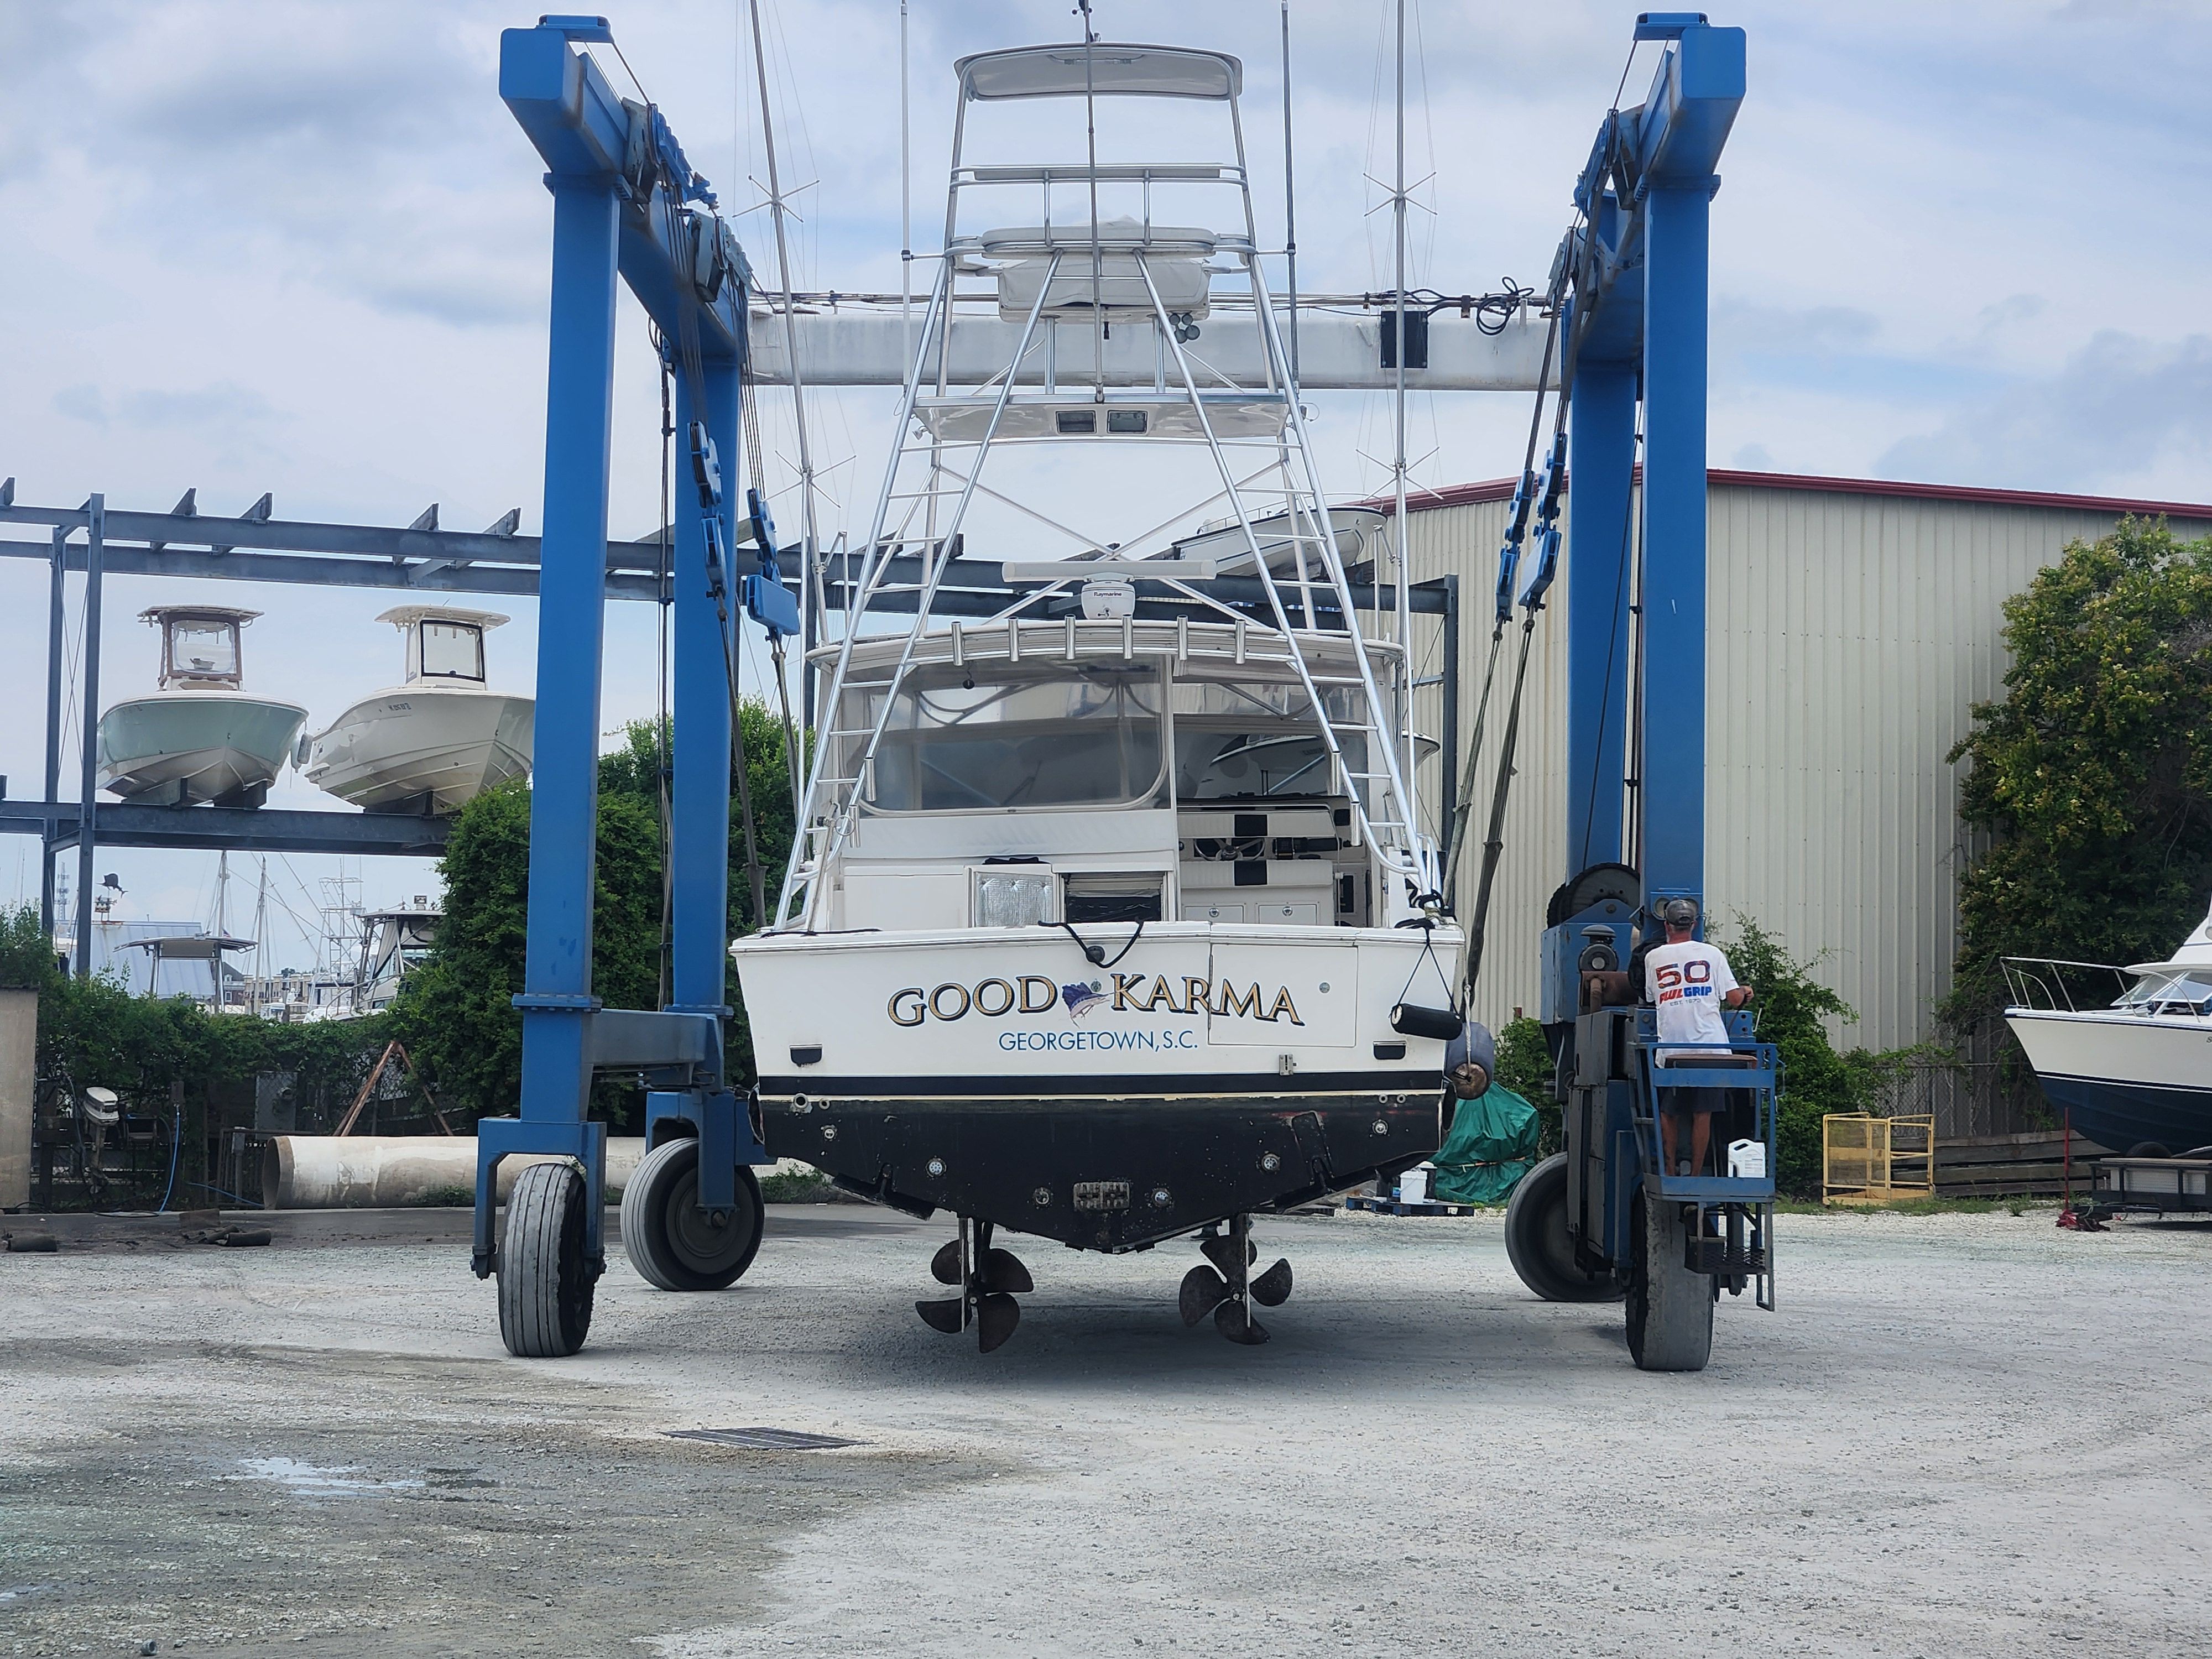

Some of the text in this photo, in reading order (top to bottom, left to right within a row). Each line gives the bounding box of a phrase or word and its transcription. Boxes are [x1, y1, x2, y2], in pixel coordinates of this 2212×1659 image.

[1656, 960, 1710, 988] 50
[888, 973, 1305, 1027] GOOD KARMA
